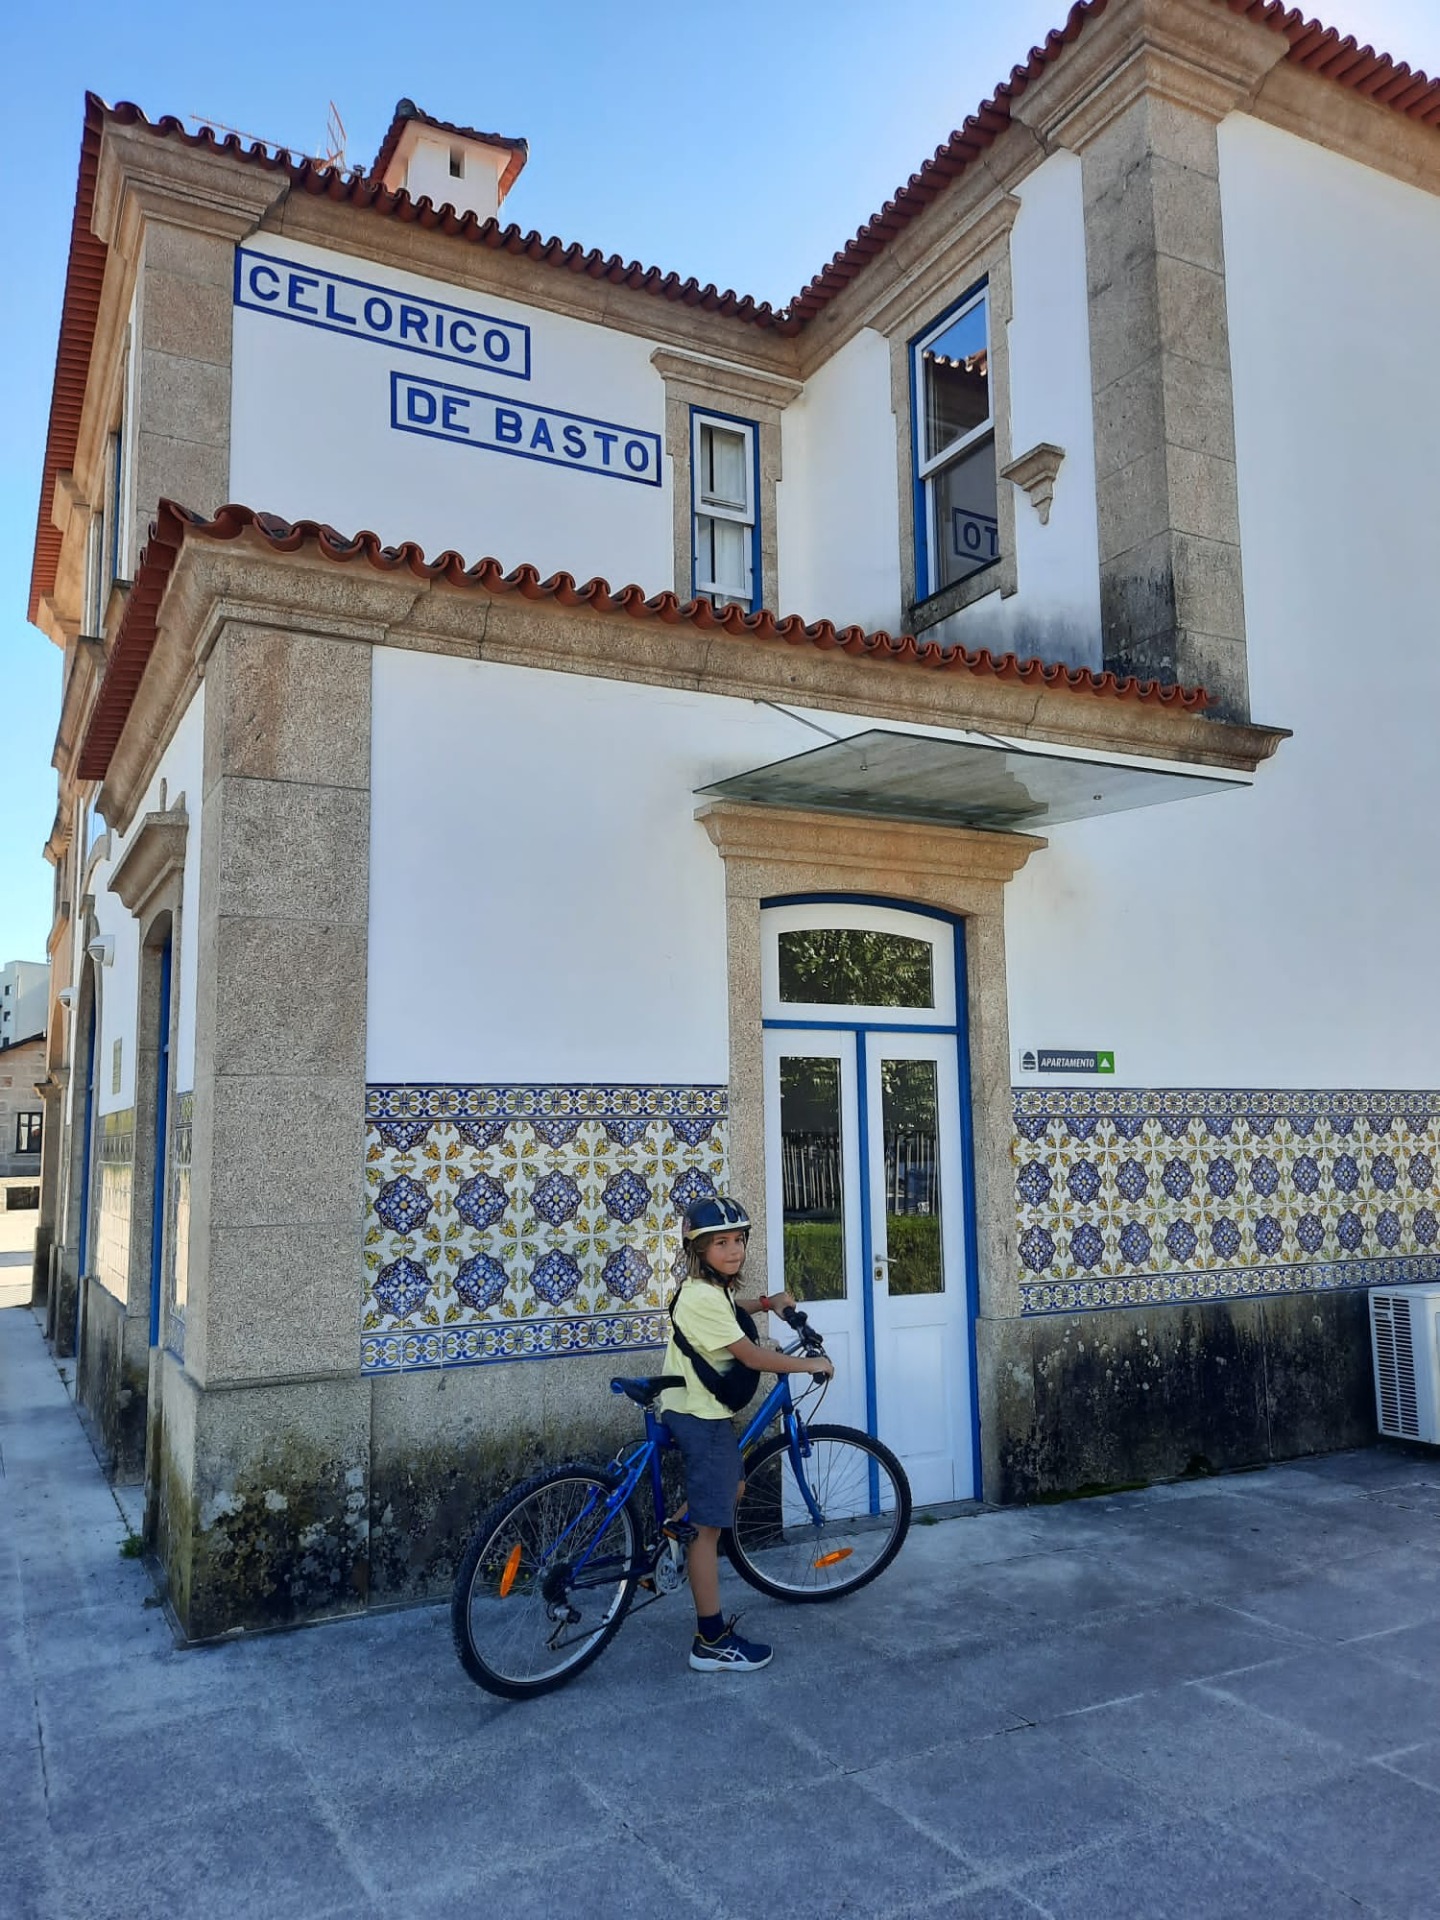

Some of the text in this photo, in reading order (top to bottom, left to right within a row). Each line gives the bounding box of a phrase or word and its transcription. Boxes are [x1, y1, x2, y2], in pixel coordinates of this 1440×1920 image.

[249, 265, 511, 363] CELORICO
[406, 386, 649, 473] DE BASTO
[1041, 1057, 1095, 1068] APARTAMENTO
